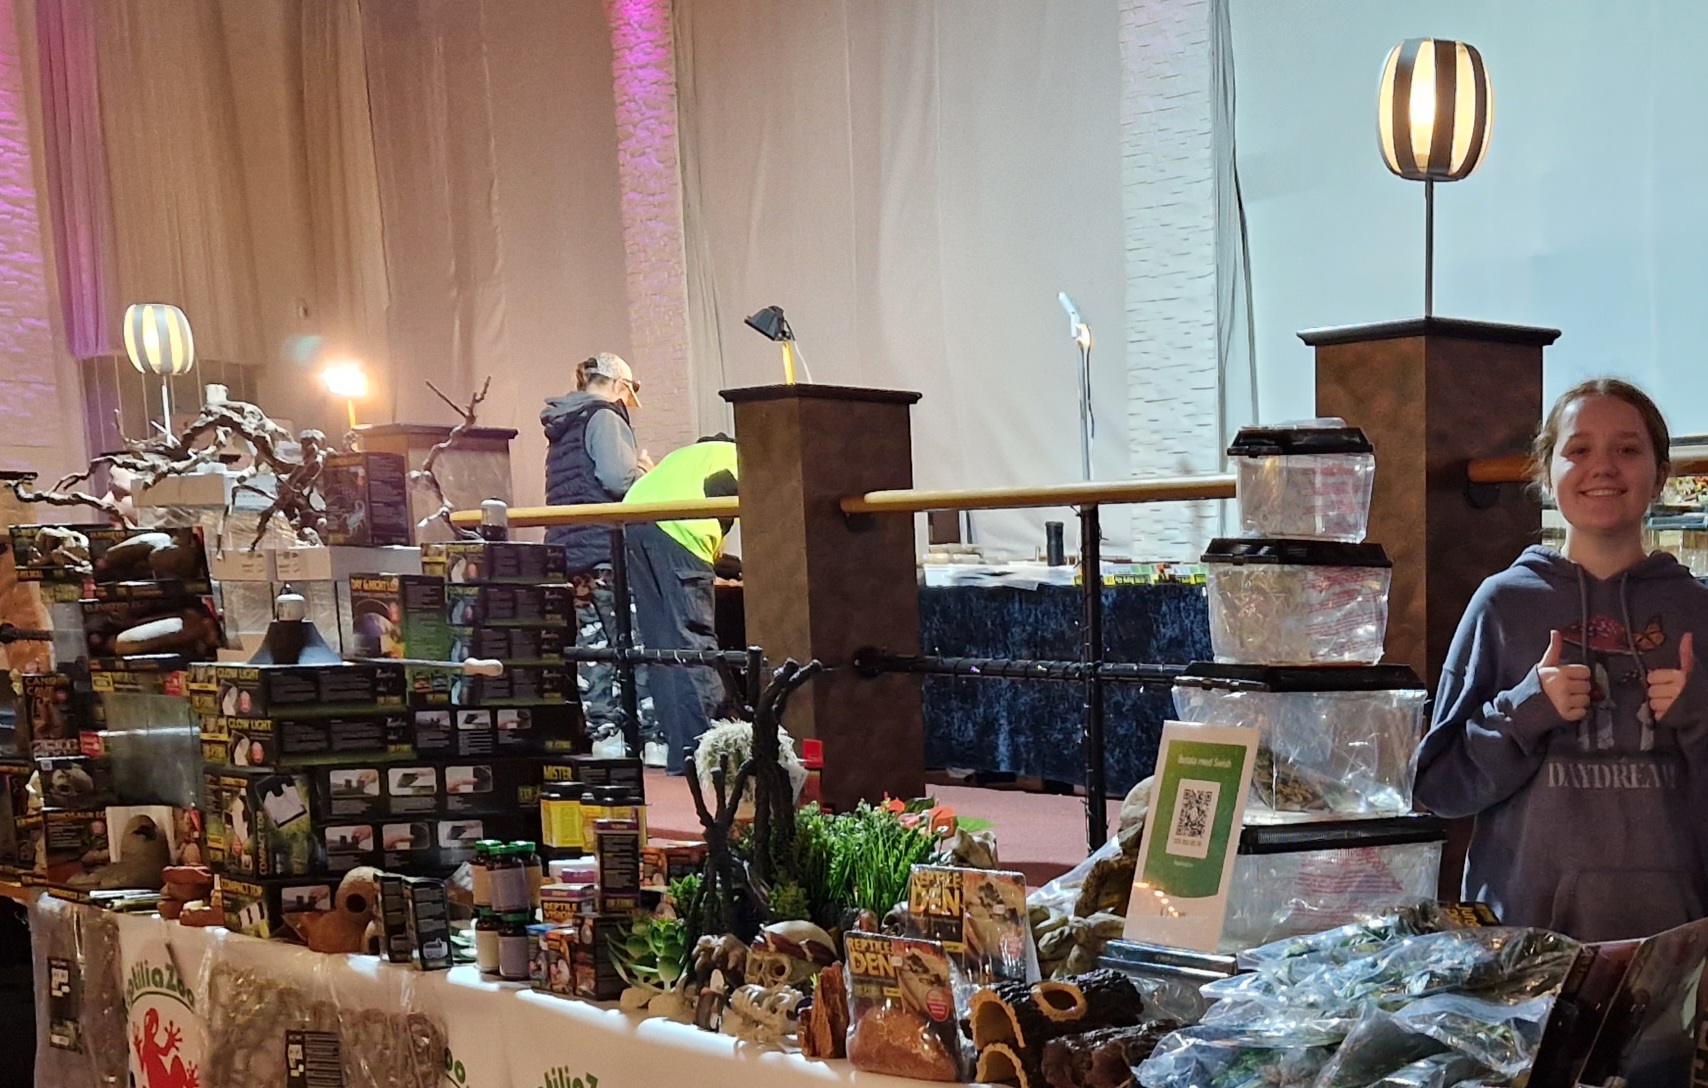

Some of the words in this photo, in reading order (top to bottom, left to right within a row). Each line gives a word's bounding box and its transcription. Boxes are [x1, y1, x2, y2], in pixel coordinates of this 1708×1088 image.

[217, 667, 238, 679] GLOW
[239, 668, 260, 680] LIGHT
[228, 719, 250, 730] GLOW
[251, 719, 273, 731] LIGHT
[543, 765, 574, 781] MISTER
[910, 888, 961, 917] DEN
[847, 937, 893, 954] REPTILE
[850, 952, 896, 977] DEN
